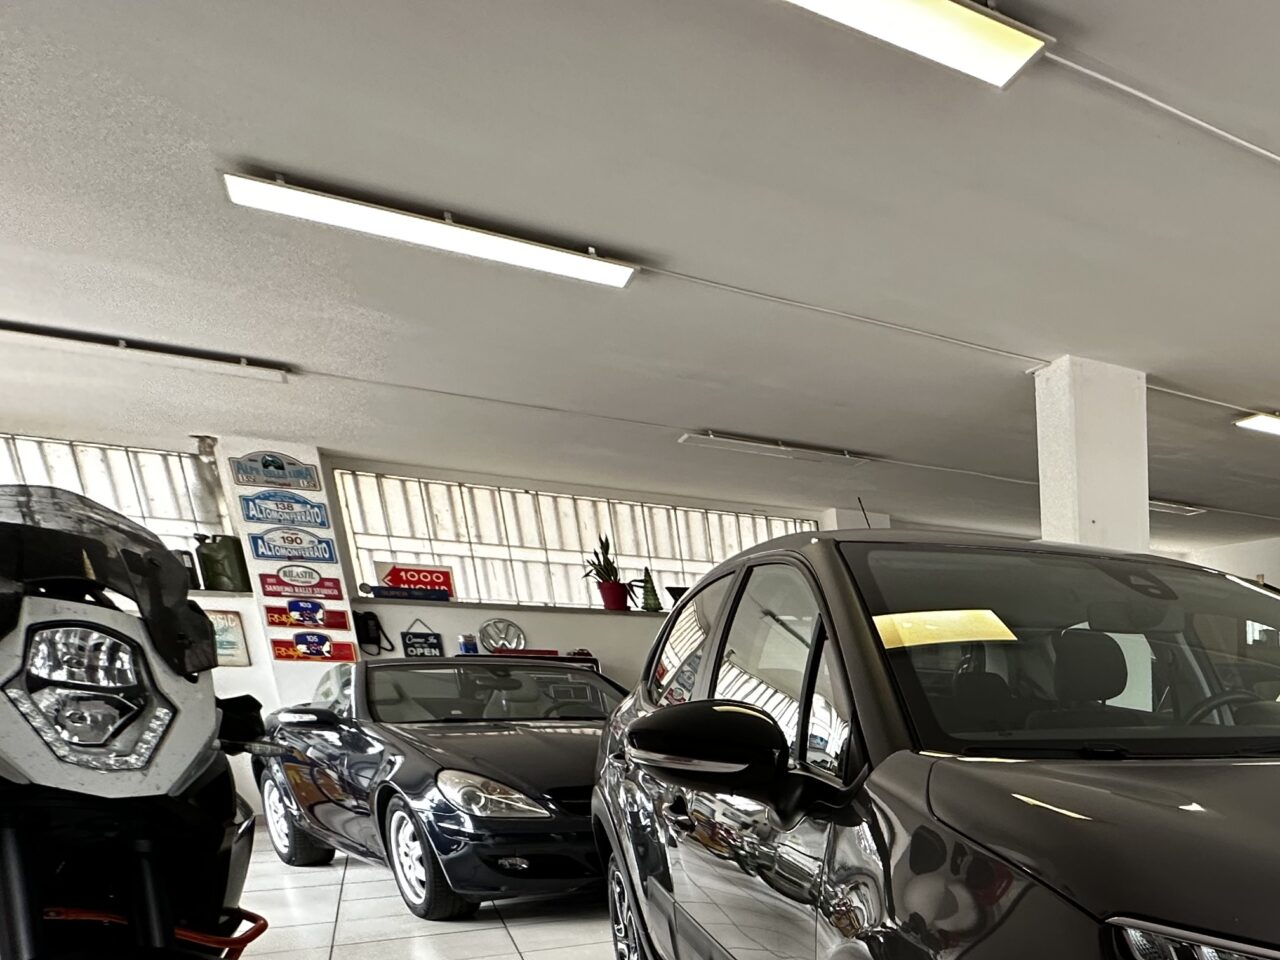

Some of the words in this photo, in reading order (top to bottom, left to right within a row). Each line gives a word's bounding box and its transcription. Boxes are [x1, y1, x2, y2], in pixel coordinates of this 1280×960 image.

[275, 502, 294, 511] 138
[281, 536, 303, 545] 190
[400, 571, 444, 582] 1000
[407, 647, 440, 656] OPEN
